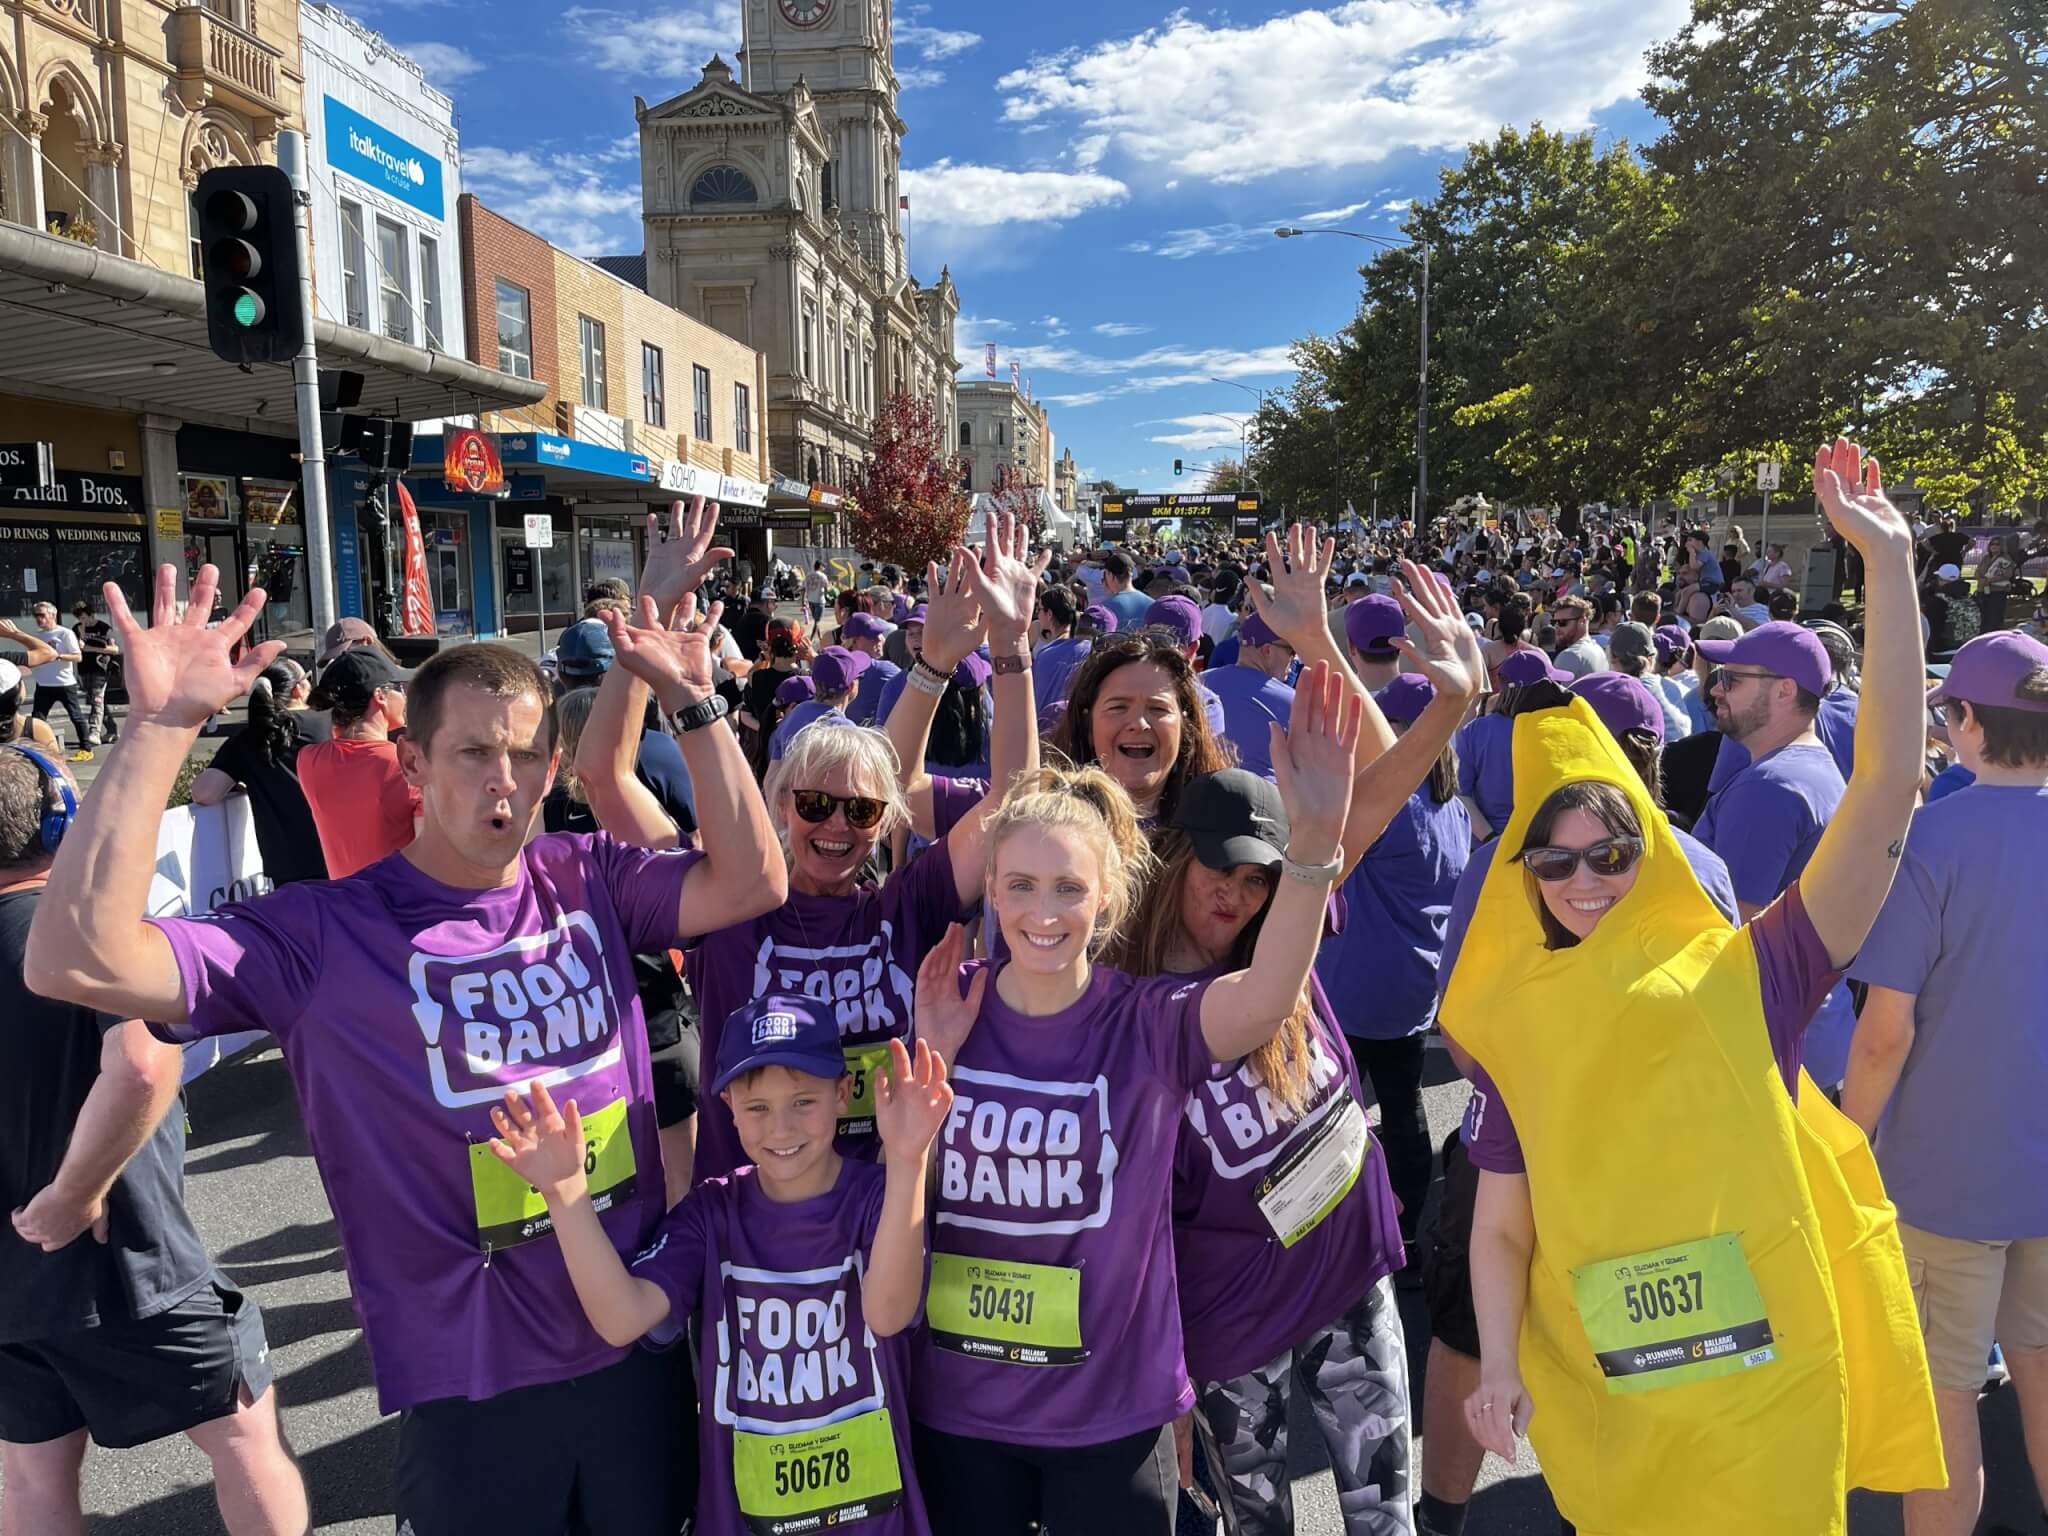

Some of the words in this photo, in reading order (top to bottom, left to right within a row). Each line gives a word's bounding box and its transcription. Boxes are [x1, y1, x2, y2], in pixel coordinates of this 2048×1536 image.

[349, 126, 410, 178] italktravel
[0, 450, 25, 465] os.
[80, 478, 128, 505] Bros.
[670, 464, 696, 491] SOHO
[1152, 507, 1171, 515] 5KM
[1174, 506, 1211, 515] 01:57:21
[14, 527, 49, 540] RINGS
[56, 528, 108, 541] WEDDING
[110, 531, 141, 542] RINGS
[450, 943, 590, 1019] FOOD
[759, 1016, 789, 1028] FOOD
[835, 986, 896, 1036] NK
[464, 986, 608, 1074] BANK
[758, 1025, 790, 1038] BANK
[1221, 1036, 1338, 1149] BAK
[944, 1095, 1081, 1156] FOOD
[942, 1148, 1083, 1208] BANK
[969, 1284, 1034, 1325] 50431
[1624, 1270, 1703, 1323] 50637
[736, 1290, 847, 1350] FOOD
[972, 1342, 1004, 1354] RUNNING
[1645, 1347, 1685, 1361] RUNNING
[1704, 1335, 1733, 1348] BALLARAT
[737, 1337, 857, 1405] BANK
[775, 1447, 850, 1496] 50678
[784, 1516, 821, 1530] RUNNING
